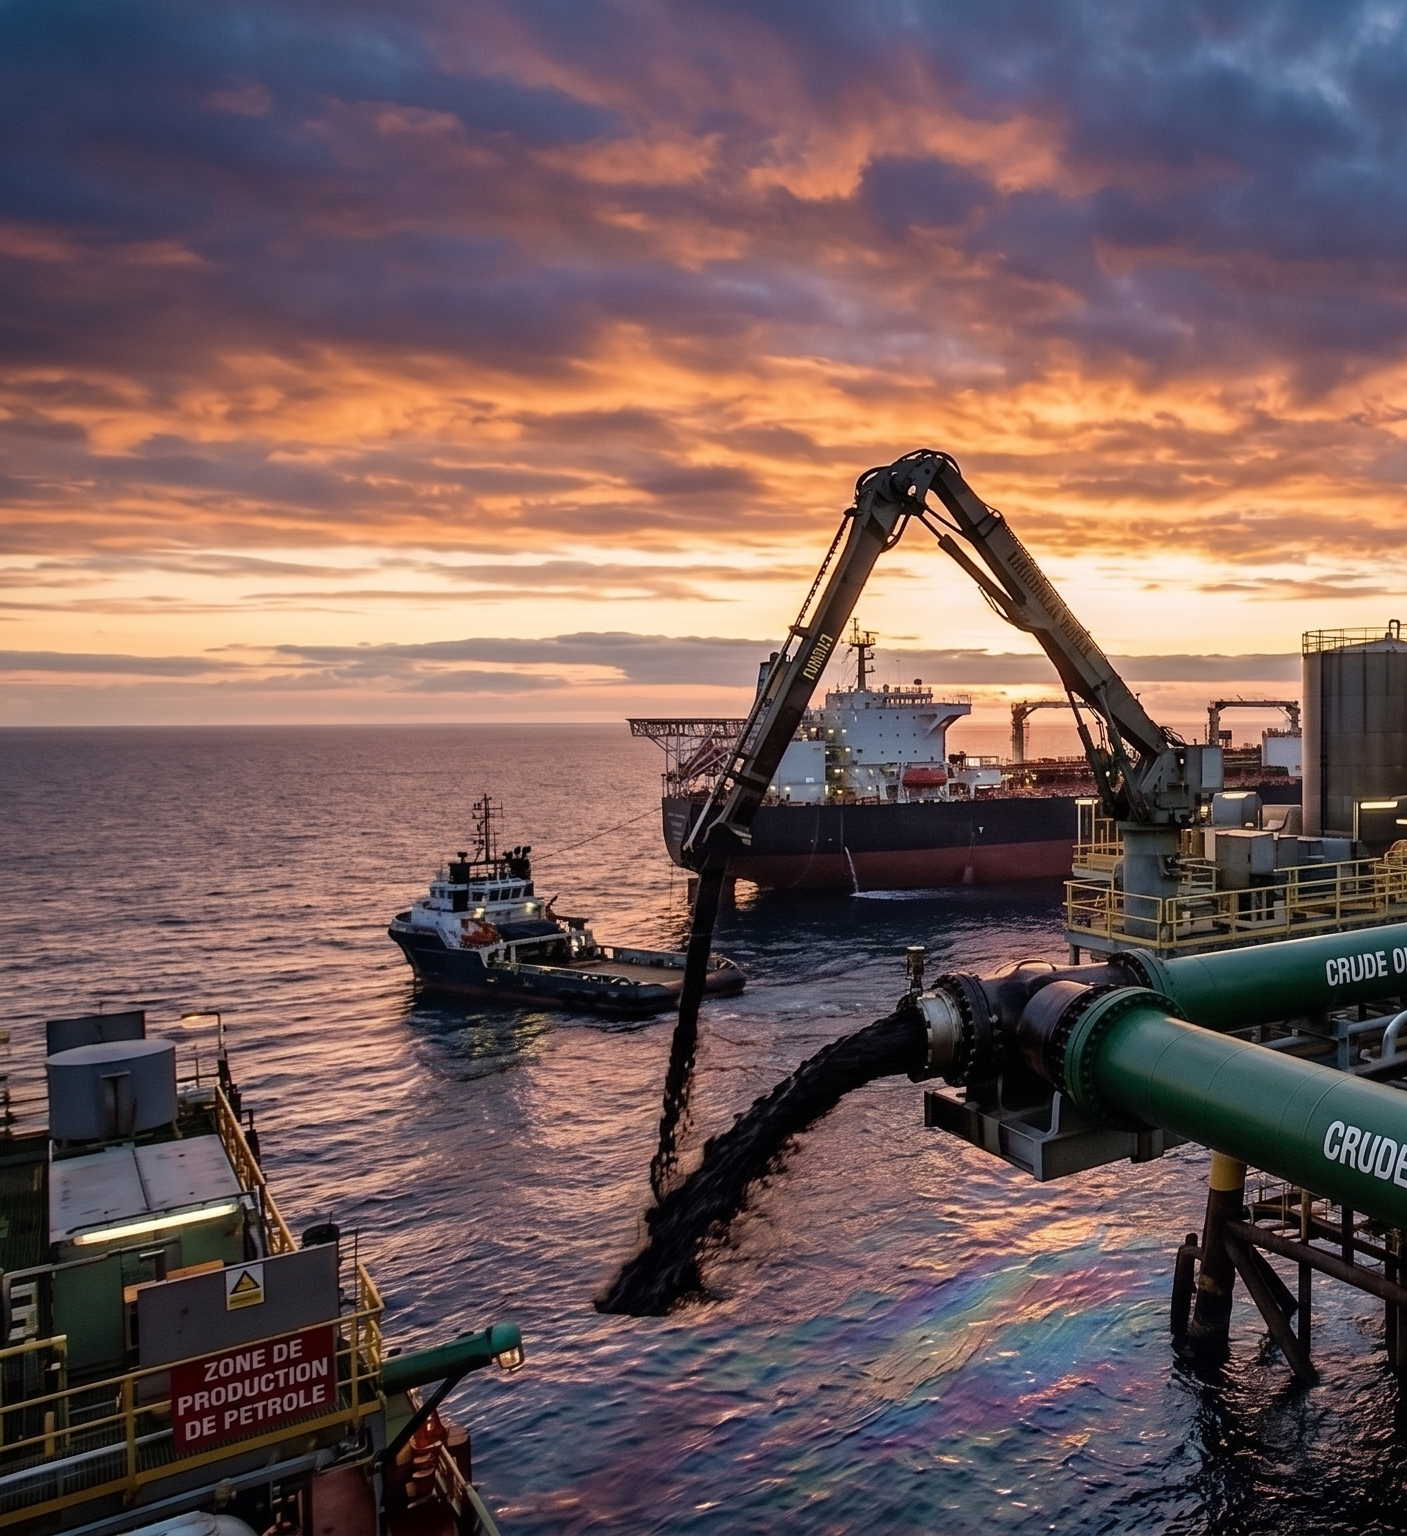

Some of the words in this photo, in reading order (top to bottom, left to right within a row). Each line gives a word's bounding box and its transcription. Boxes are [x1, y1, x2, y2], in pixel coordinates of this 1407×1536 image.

[1326, 949, 1388, 987] CRUDE
[204, 1348, 266, 1382] ZONE
[273, 1338, 302, 1364] DE
[178, 1357, 328, 1416] PRODUCTION
[185, 1415, 217, 1441] DE
[224, 1384, 326, 1430] PETROLE
